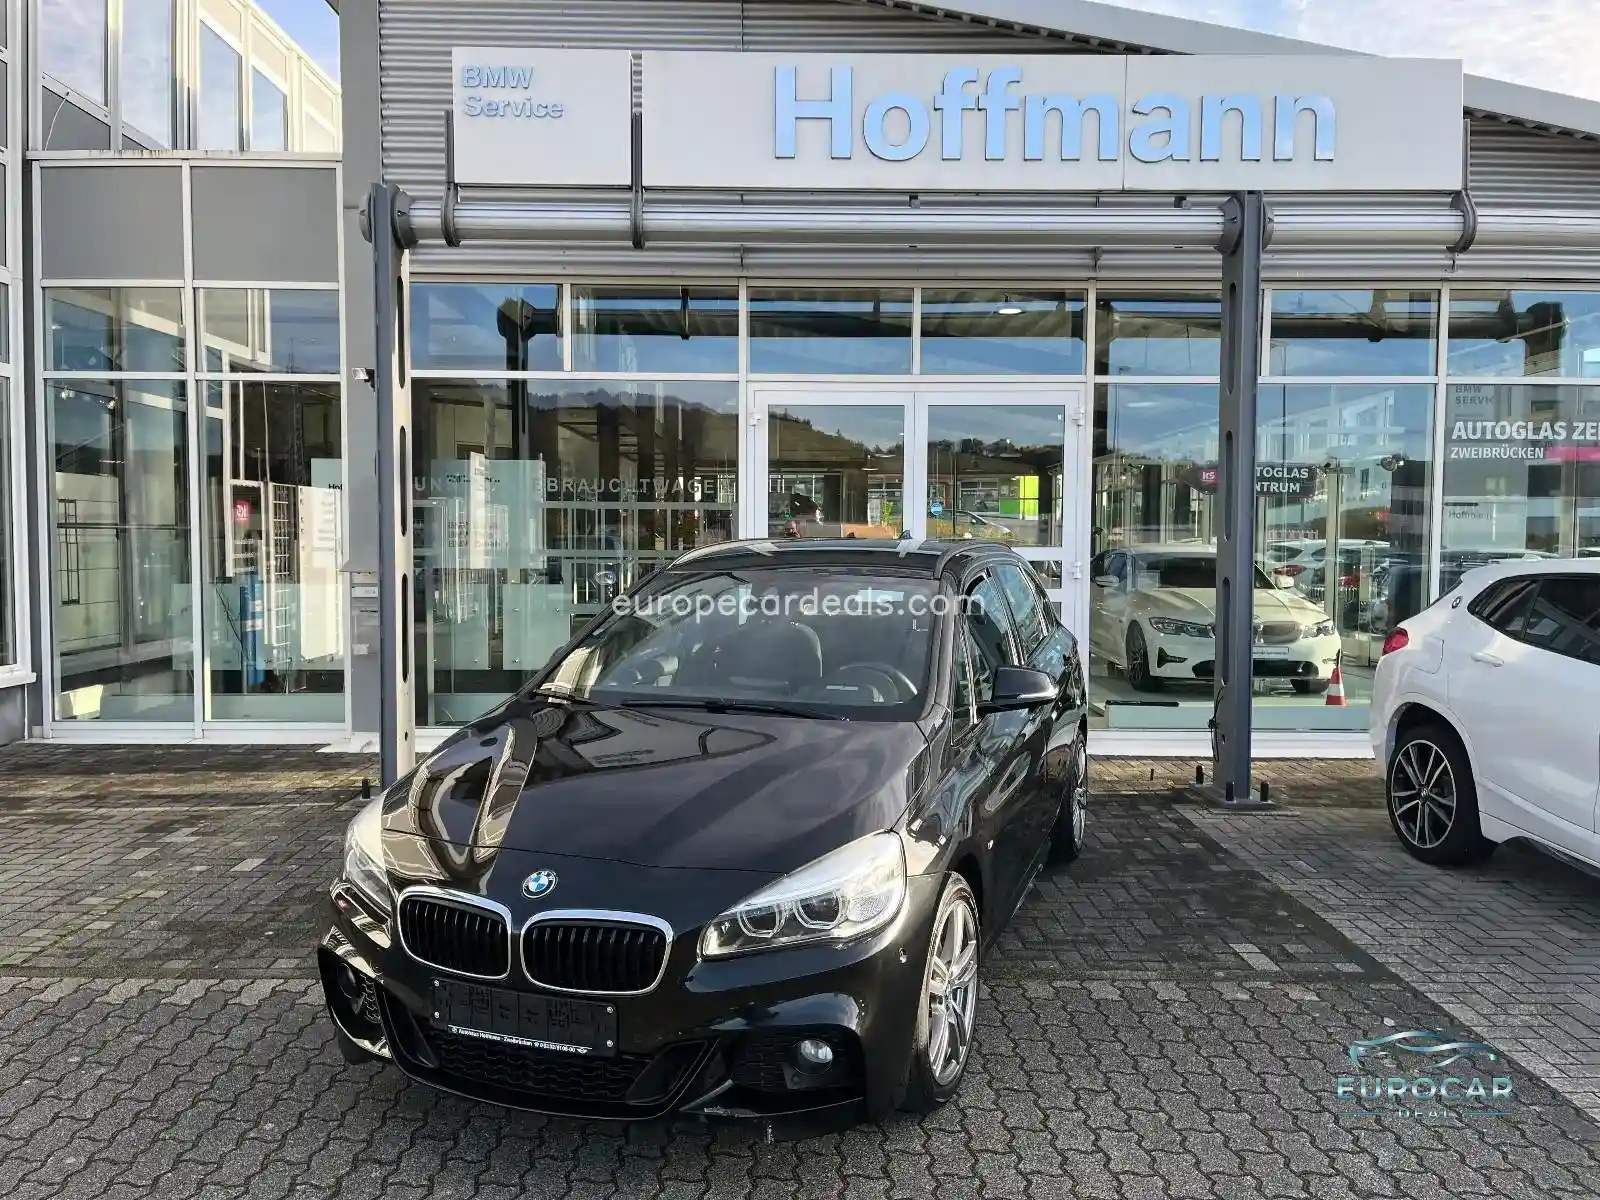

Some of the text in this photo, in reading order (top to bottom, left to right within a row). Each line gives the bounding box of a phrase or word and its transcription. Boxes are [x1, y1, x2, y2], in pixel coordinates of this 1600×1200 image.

[462, 65, 534, 89] BMW
[464, 95, 564, 118] Service
[774, 65, 1336, 163] Hoffmann
[1451, 421, 1600, 440] AUTOGLAS ZE
[1450, 444, 1544, 459] ZWEIBRÜCKEN
[1256, 466, 1309, 479] TOGLAS
